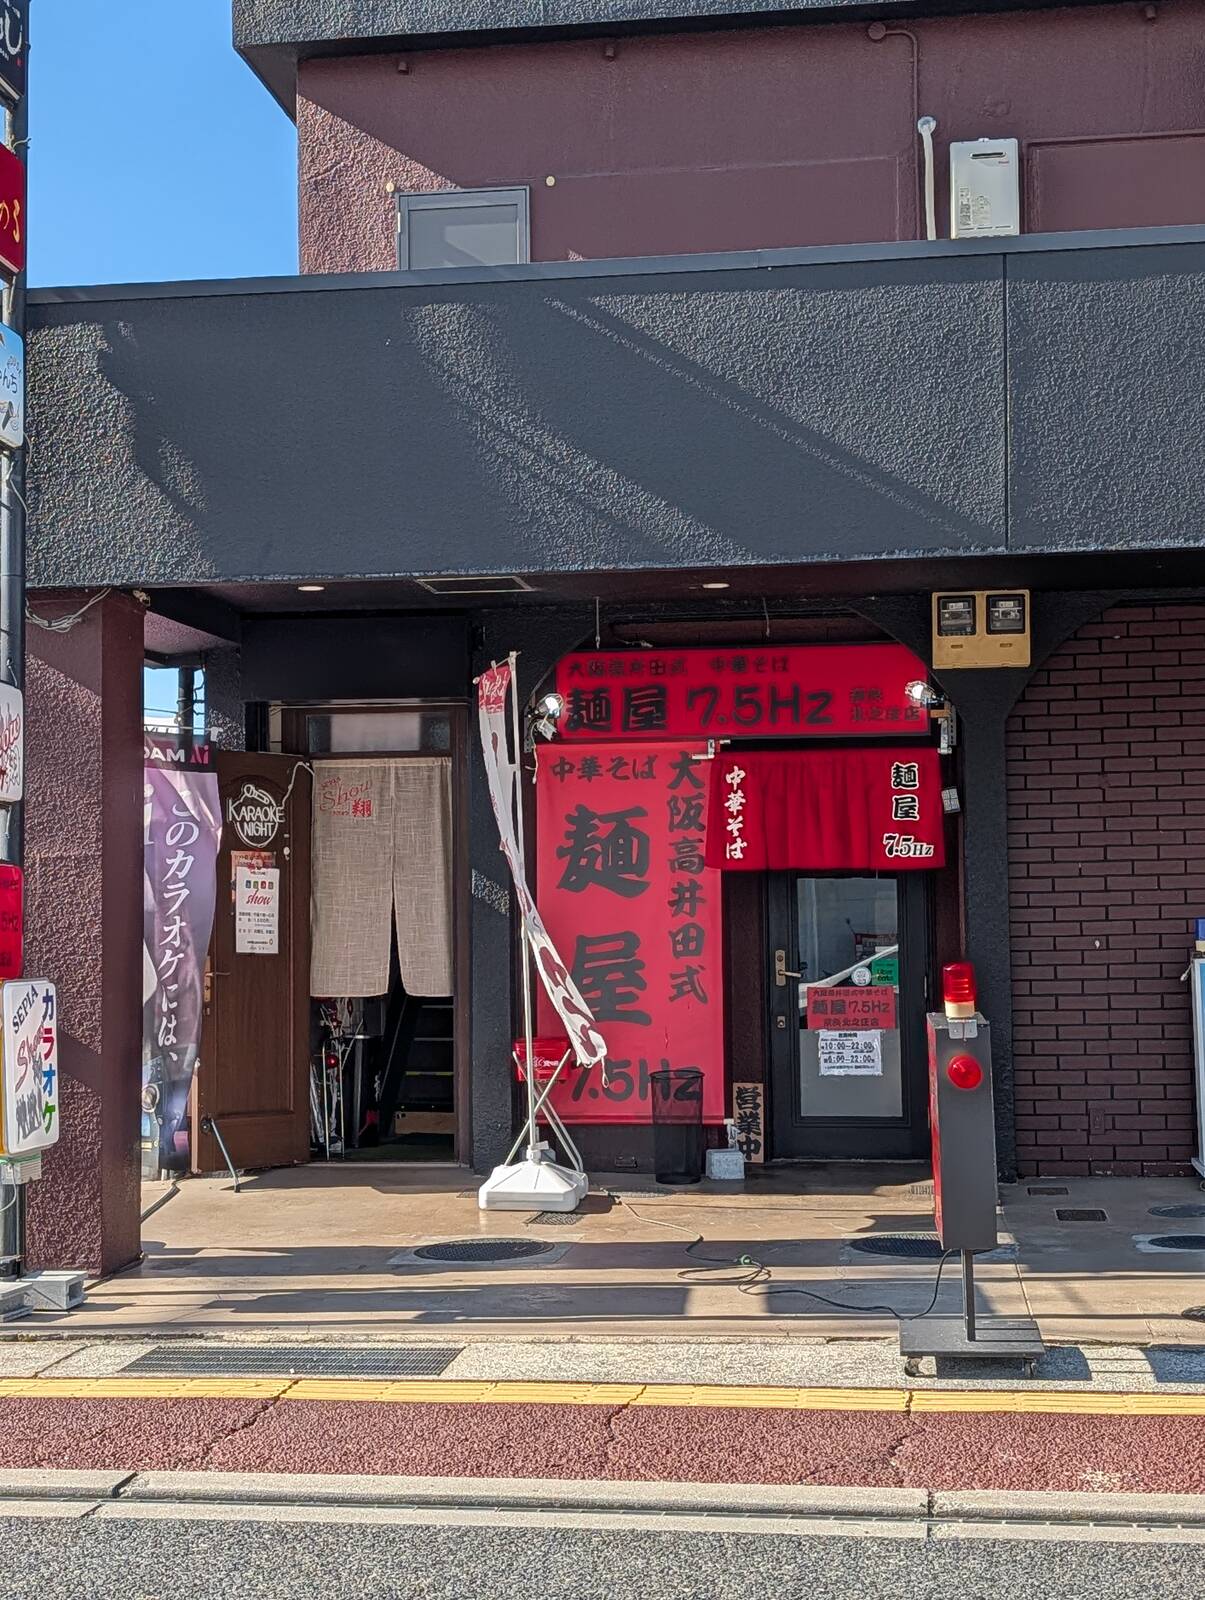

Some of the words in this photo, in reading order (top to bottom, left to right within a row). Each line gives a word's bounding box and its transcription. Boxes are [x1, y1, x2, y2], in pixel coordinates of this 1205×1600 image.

[565, 684, 667, 730] 麺屋
[687, 681, 833, 728] 7.5Hz
[549, 755, 658, 783] 中華そば
[891, 762, 920, 820] 麺屋
[228, 799, 286, 823] KARAOKE
[243, 821, 275, 837] NIGHT
[724, 765, 747, 860] 中華そば
[883, 833, 934, 857] 7.5Hz
[665, 750, 708, 1005] 大阪高井田式
[555, 803, 652, 1026] 麺屋
[13, 984, 39, 1034] SEPIA
[848, 999, 891, 1014] 7.5Hz
[42, 988, 56, 1134] カラオケ
[736, 1086, 762, 1161] 営業中
